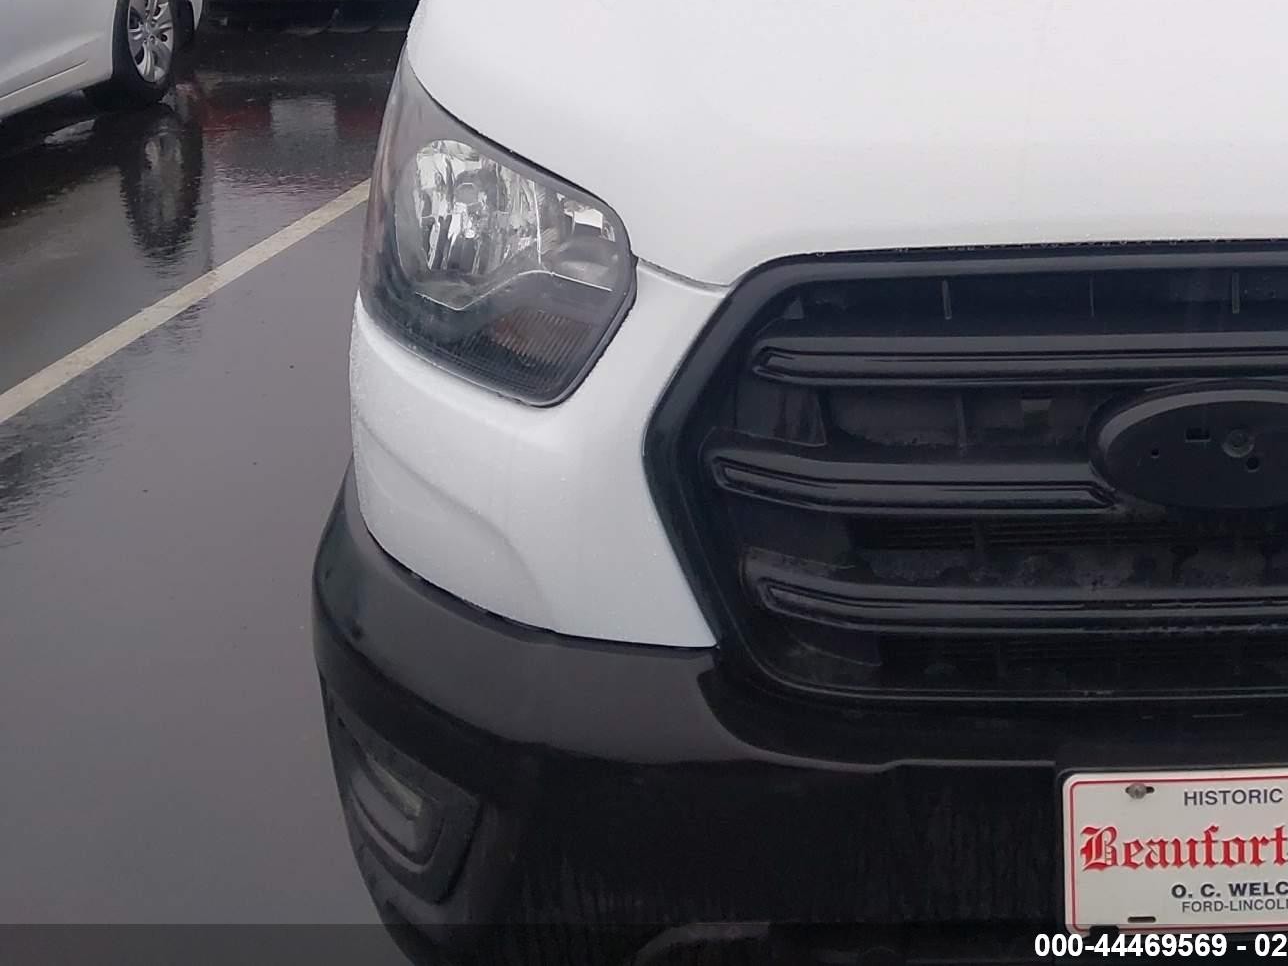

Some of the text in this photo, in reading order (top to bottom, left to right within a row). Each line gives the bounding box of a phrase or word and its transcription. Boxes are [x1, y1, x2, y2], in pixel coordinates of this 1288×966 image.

[1183, 788, 1284, 806] HISTORIC
[1080, 825, 1288, 872] Beaufort
[1171, 884, 1193, 899] O.
[1200, 883, 1222, 898] C.
